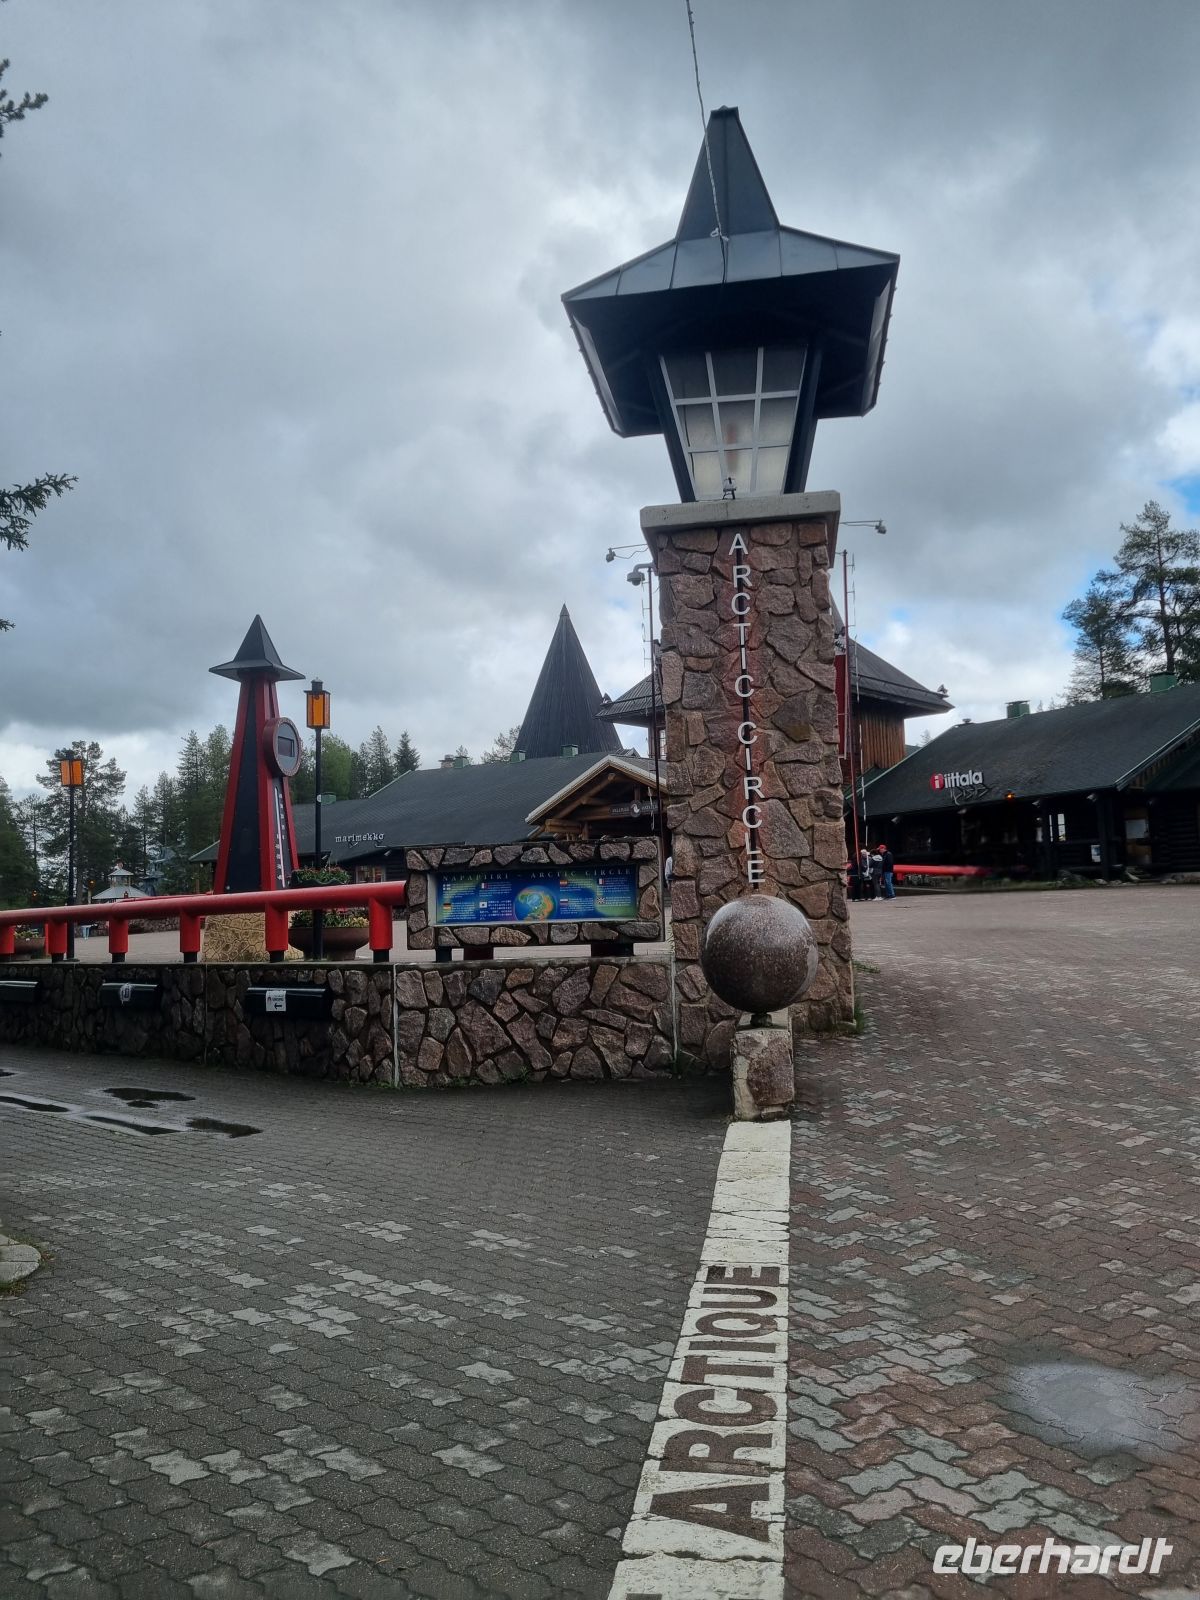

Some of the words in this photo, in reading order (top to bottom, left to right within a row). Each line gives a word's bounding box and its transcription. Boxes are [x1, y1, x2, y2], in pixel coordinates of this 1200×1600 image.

[728, 533, 755, 698] ARCTIC
[738, 721, 765, 883] CIRCLE
[944, 769, 983, 789] iittala
[335, 832, 385, 843] marimekko
[443, 873, 508, 881] NAPAPIIRI
[530, 870, 577, 879] ARCTIC
[585, 868, 631, 876] CIRCLE
[650, 1265, 781, 1543] ARCTIQUE
